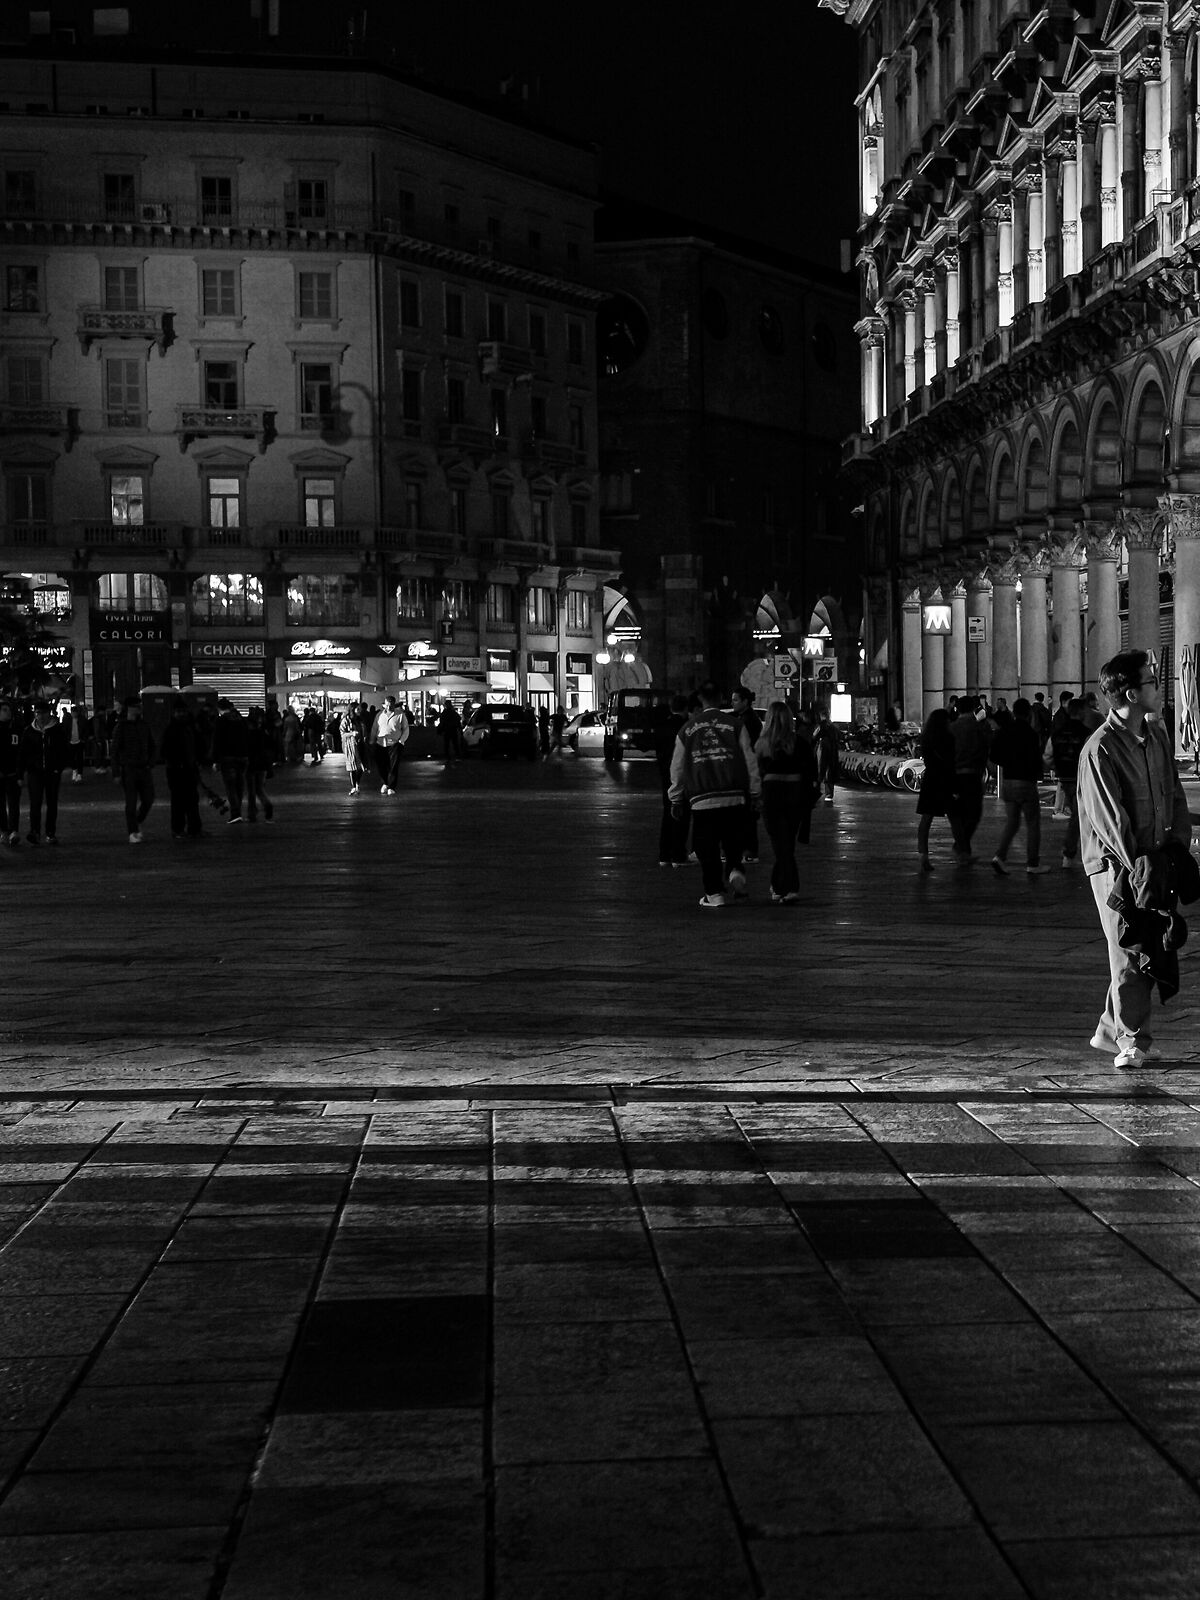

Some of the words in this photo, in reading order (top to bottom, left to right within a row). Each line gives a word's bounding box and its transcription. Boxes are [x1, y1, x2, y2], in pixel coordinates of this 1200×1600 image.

[925, 609, 951, 630] M
[99, 630, 162, 640] CALORI
[203, 644, 263, 656] CHANGE
